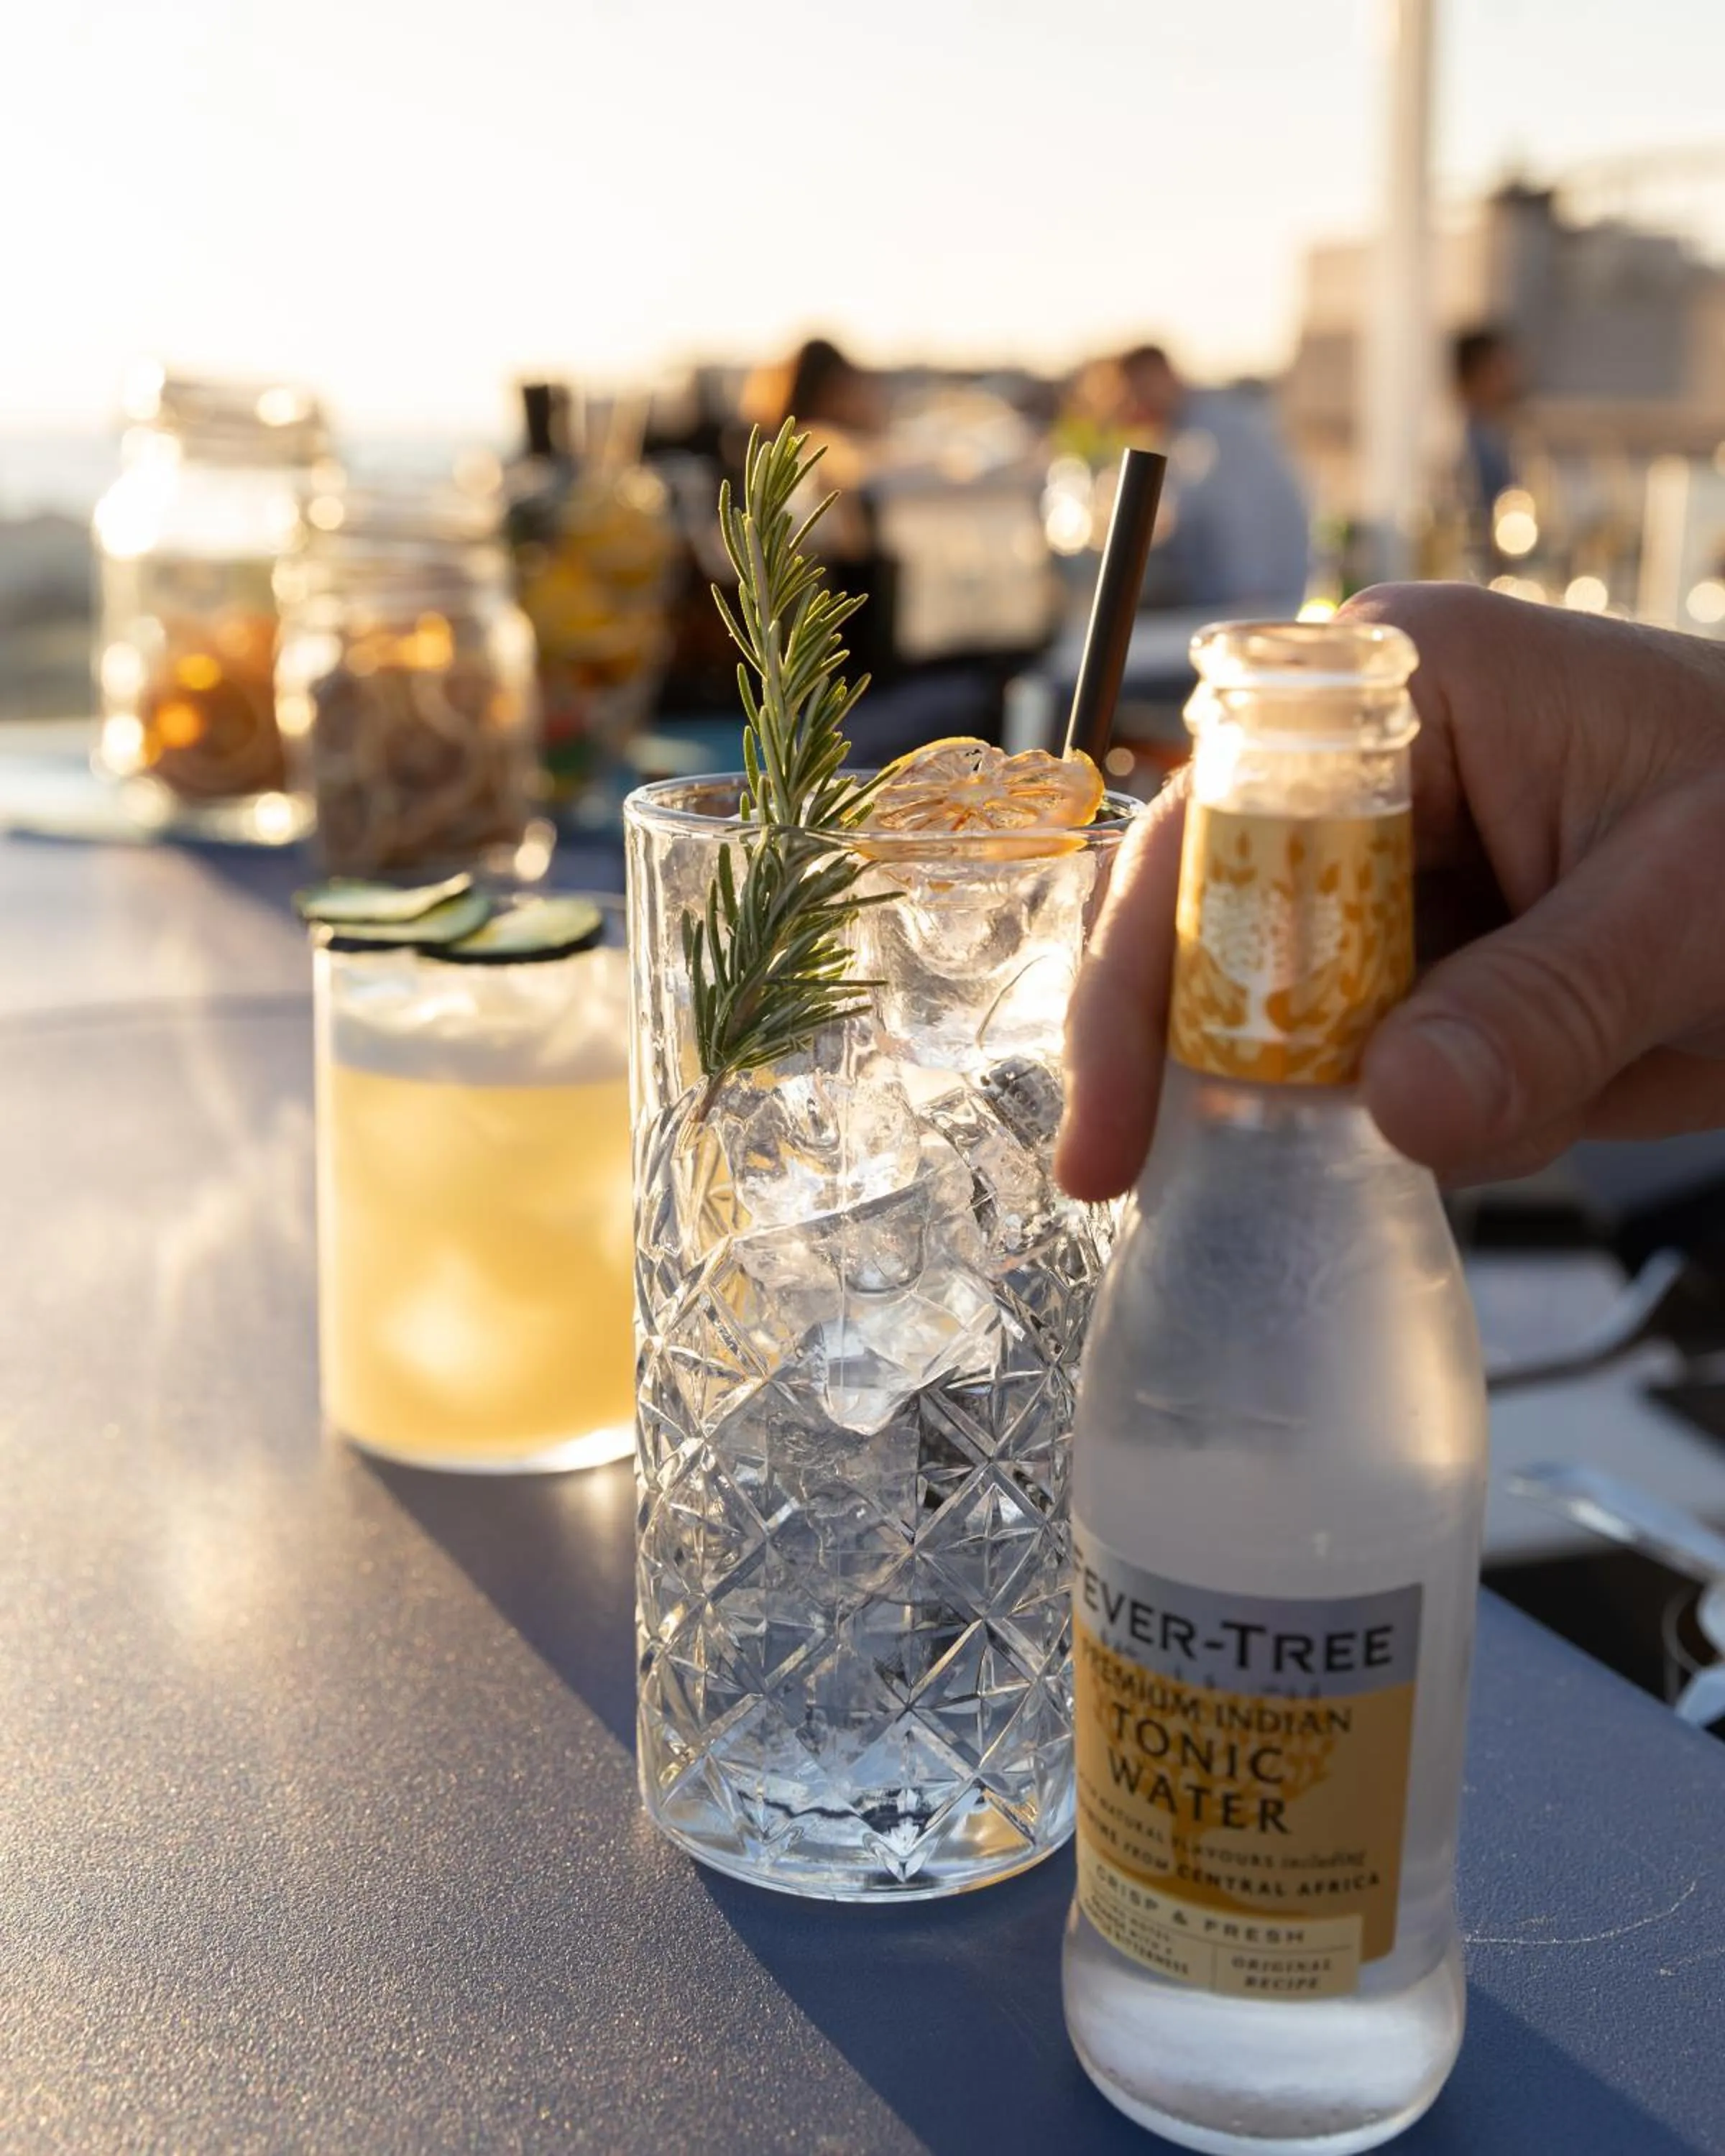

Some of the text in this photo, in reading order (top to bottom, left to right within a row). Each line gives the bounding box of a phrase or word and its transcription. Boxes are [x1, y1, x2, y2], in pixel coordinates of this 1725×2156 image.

[1112, 1703, 1284, 1784] TONIC
[1216, 1704, 1353, 1736] INDIAN
[1108, 1746, 1292, 1834] WATER
[1123, 1842, 1380, 1897] FROM CENTRAL AFRICA
[1096, 1864, 1159, 1910] CRISP
[1204, 1918, 1305, 1943] FRESH
[1231, 1955, 1332, 1973] ORIGINAL
[1244, 1976, 1318, 1990] RECIPE
